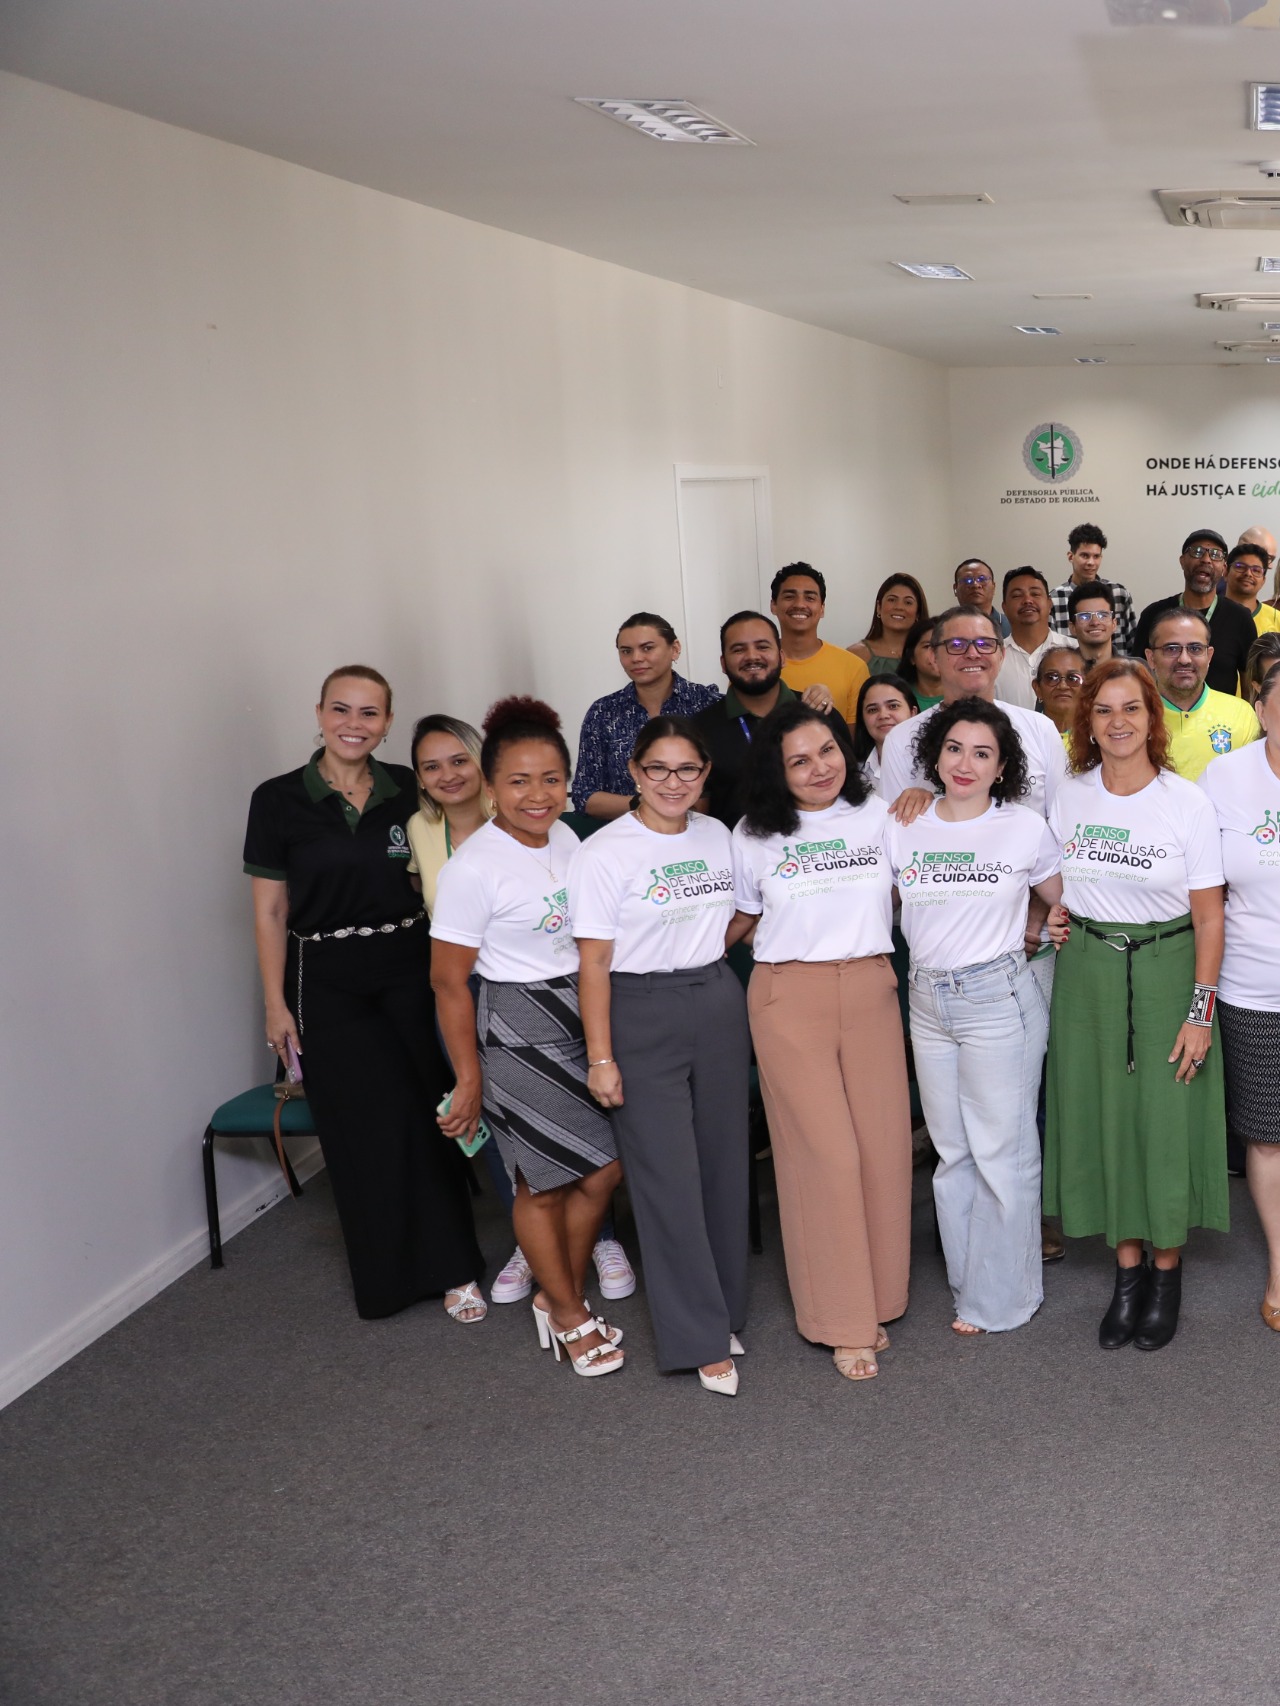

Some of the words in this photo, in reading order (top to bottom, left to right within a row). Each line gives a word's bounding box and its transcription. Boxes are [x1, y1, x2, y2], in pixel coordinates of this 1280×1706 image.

[1146, 457, 1190, 470] ONDE
[1194, 454, 1216, 469] HÁ
[1006, 489, 1057, 497] DEFENSORIA
[1060, 487, 1094, 496] PÚBLICA
[1146, 481, 1168, 496] HÁ
[1171, 484, 1235, 499] JUSTIÇA
[1238, 484, 1246, 496] E
[1084, 826, 1128, 841] CENSO
[797, 840, 844, 854] CENSO
[800, 853, 820, 864] DE
[822, 845, 883, 861] INCLUSÃO
[1080, 838, 1099, 849] DE
[1100, 839, 1167, 859] INCLUSÃO
[803, 864, 812, 874] E
[814, 856, 878, 872] CUIDADO
[925, 853, 972, 863] CENSO
[1076, 849, 1086, 860] E
[1088, 850, 1152, 870] CUIDADO
[664, 861, 705, 876] CENSO
[922, 863, 942, 873] DE
[944, 861, 1013, 875] INCLUSÃO
[669, 876, 686, 888] DE
[688, 868, 733, 884] INCLUSÃ
[837, 871, 880, 883] respeitar
[920, 874, 929, 884] E
[932, 873, 999, 884] CUIDADO
[1104, 869, 1149, 884] respeitar
[674, 889, 682, 900] E
[951, 888, 996, 899] respeitar
